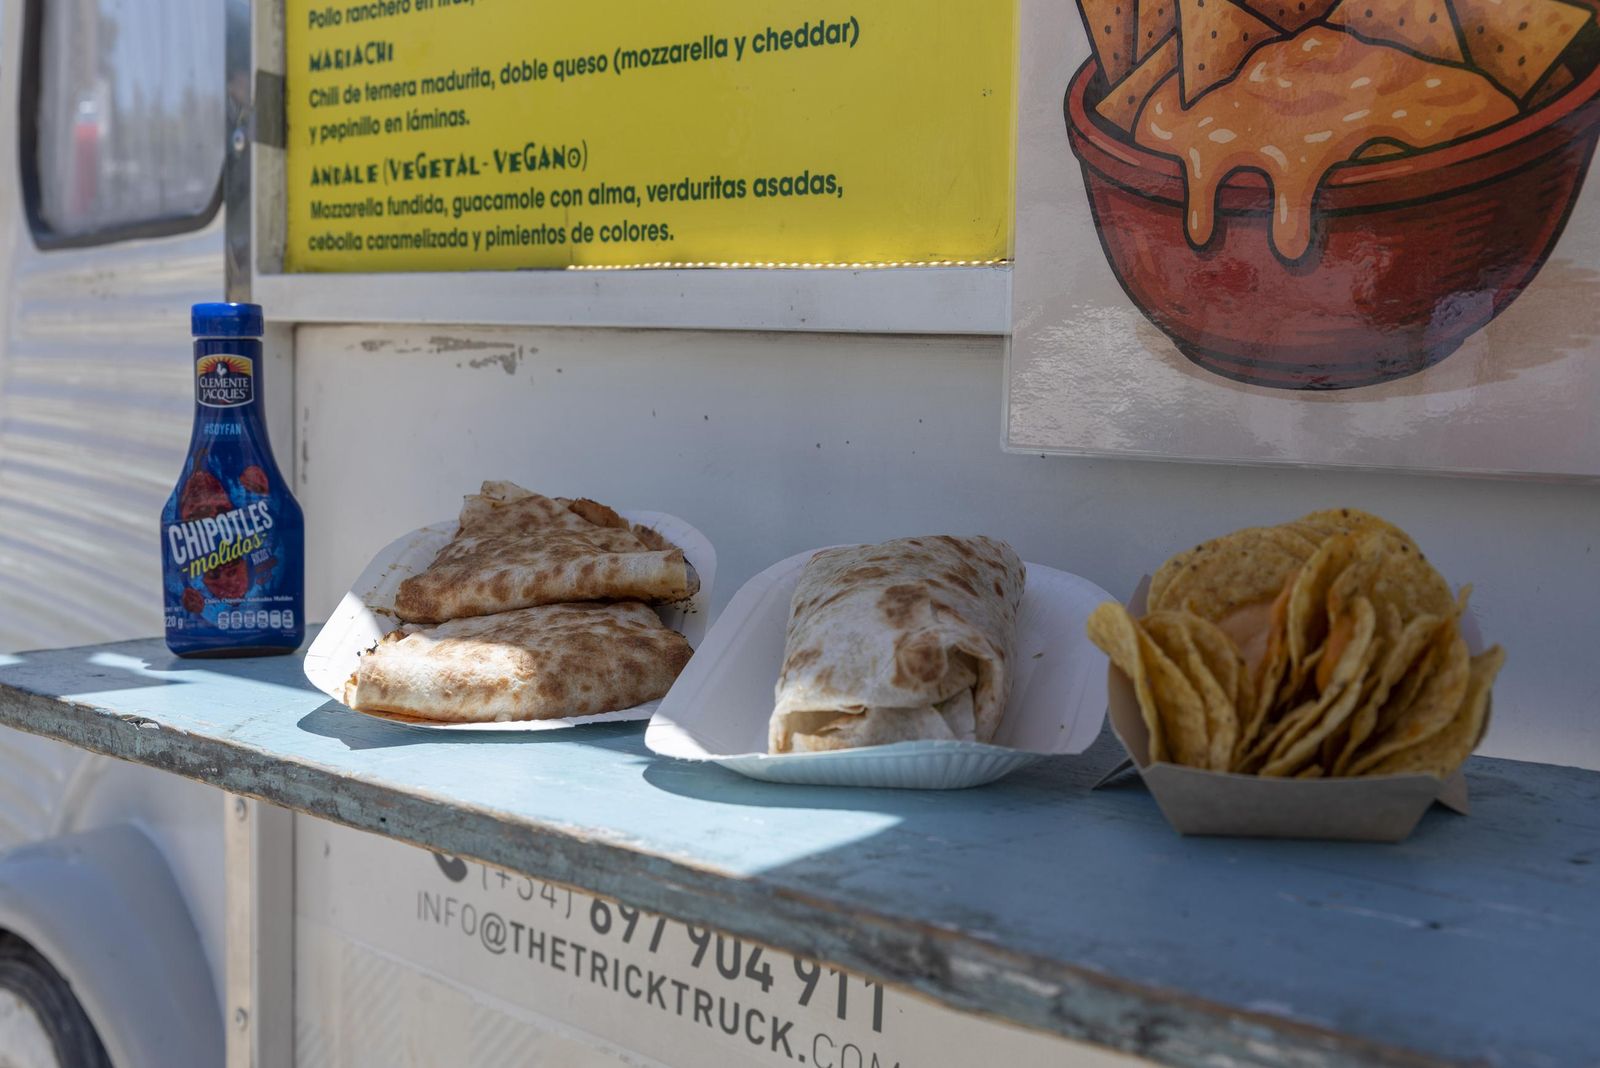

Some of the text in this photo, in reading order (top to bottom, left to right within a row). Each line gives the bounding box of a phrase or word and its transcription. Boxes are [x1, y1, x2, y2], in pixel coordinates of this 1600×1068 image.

[308, 9, 342, 29] Pollo
[346, 0, 410, 23] ranchero
[308, 15, 860, 108] Chili de ternera madurita, doble queso (mozzarella y cheddar)
[309, 41, 394, 72] MARIACHI
[309, 107, 470, 144] y pepinillo en láminas.
[310, 163, 378, 187] ANDALE
[310, 169, 843, 219] Mozzarella fundida, guacamole con alma, verduritas asadas,
[308, 219, 674, 252] cebolla caramelizada y pimientos de colores.
[200, 377, 248, 388] CLEMENTE
[202, 388, 246, 401] JACQUES
[168, 500, 273, 565] CHIPOTLES
